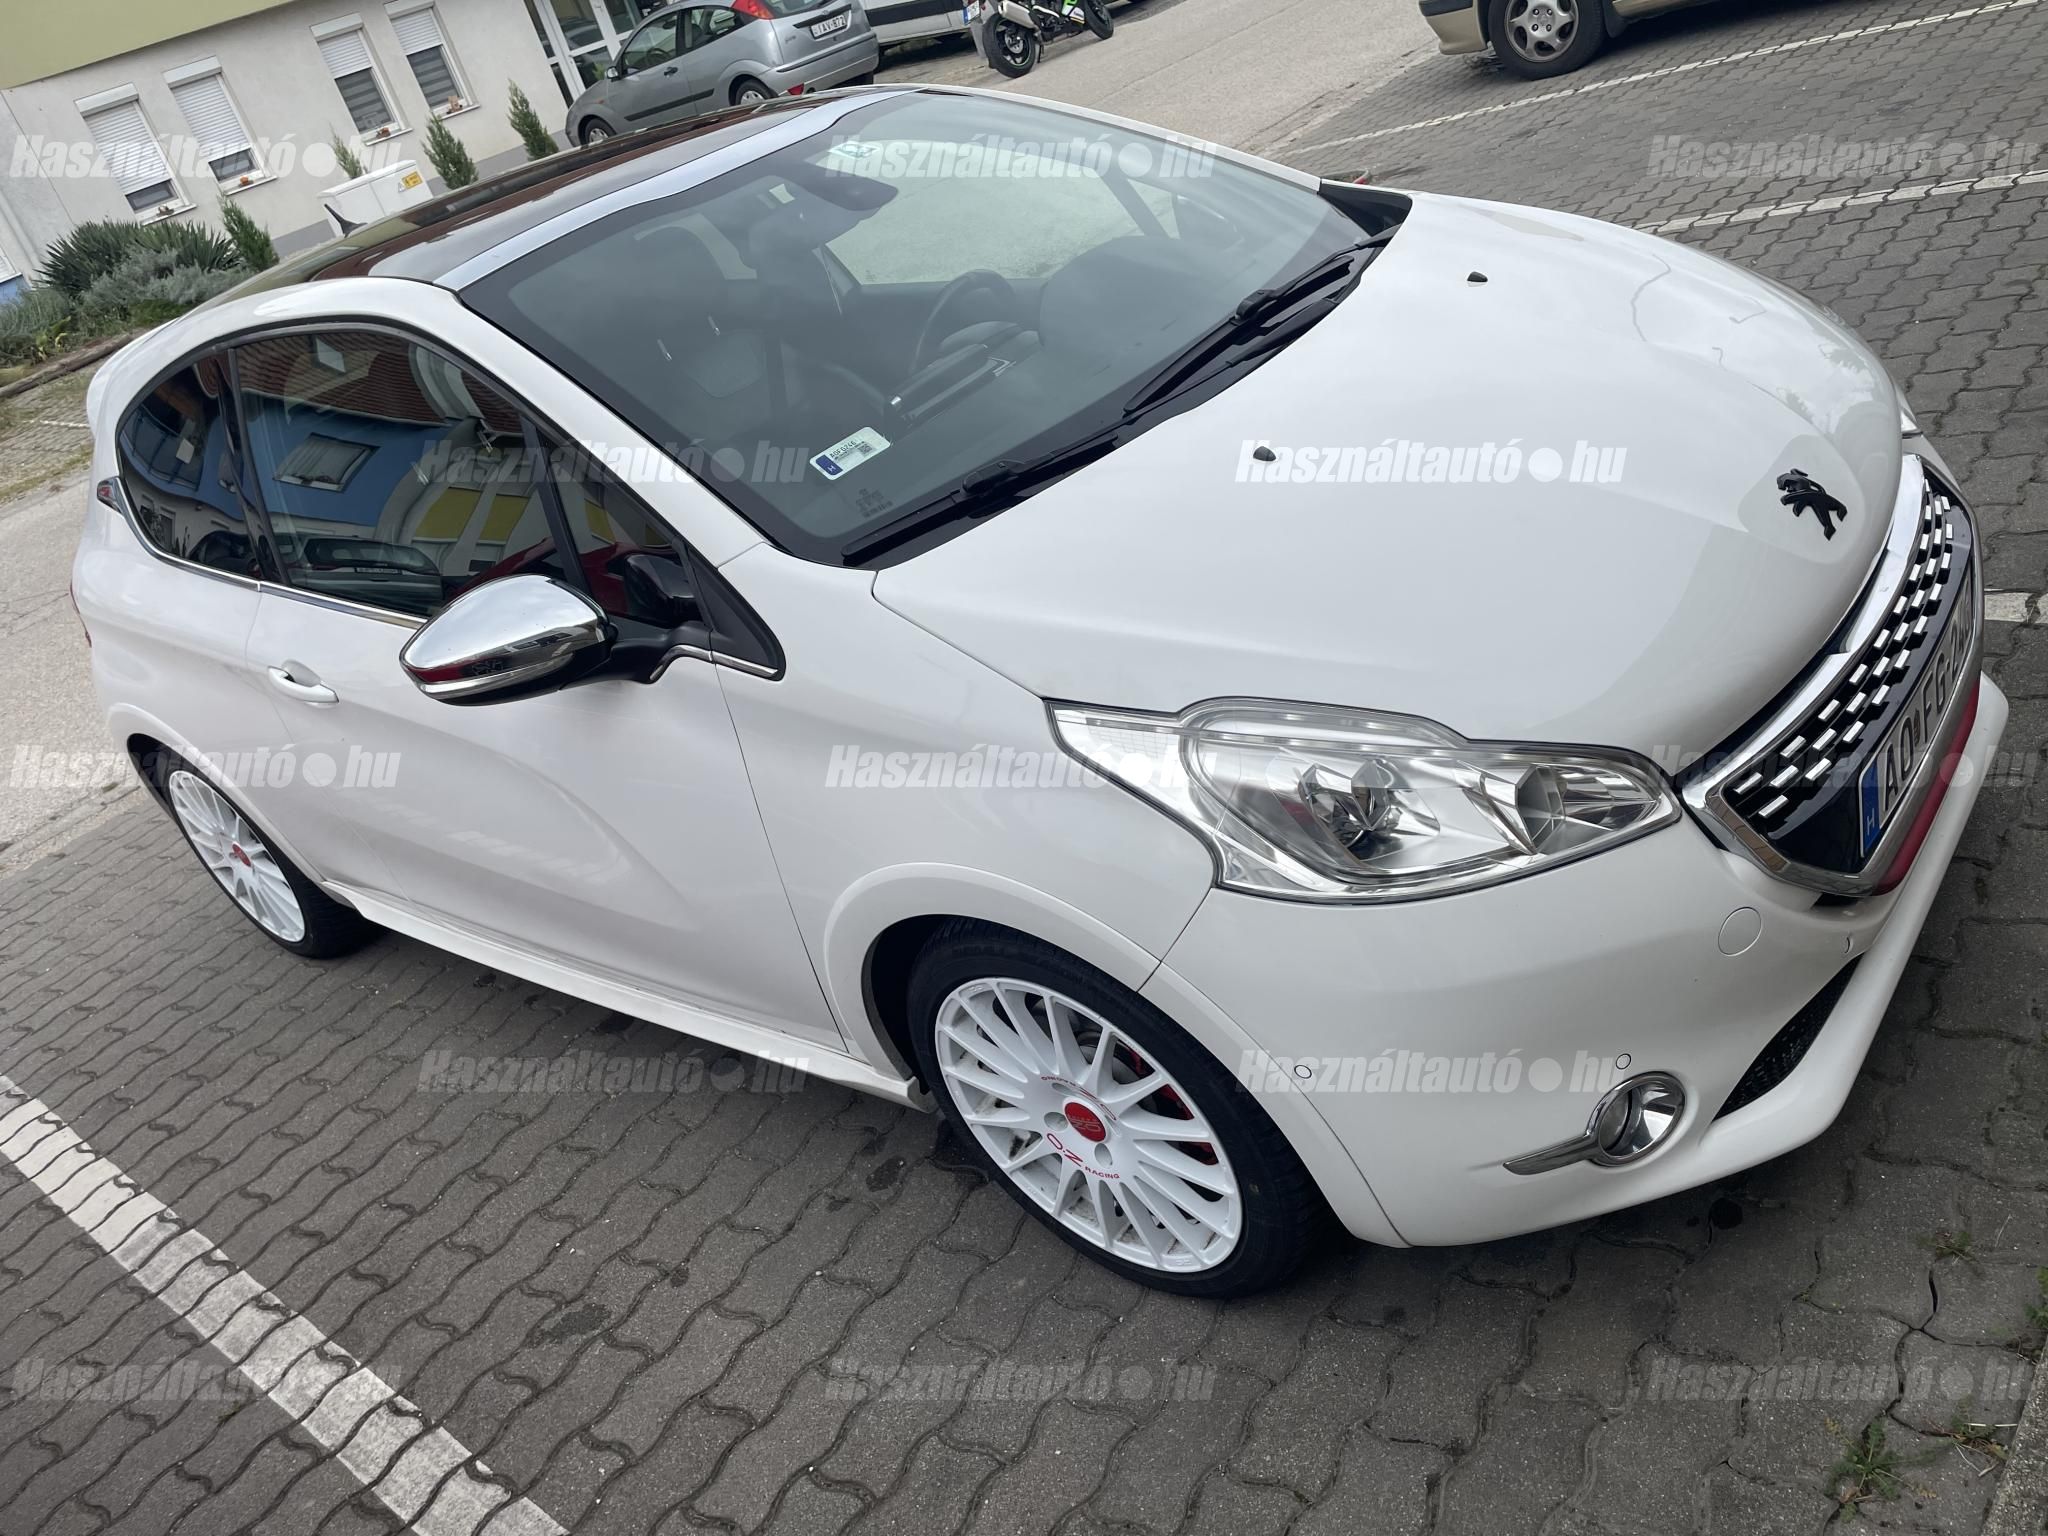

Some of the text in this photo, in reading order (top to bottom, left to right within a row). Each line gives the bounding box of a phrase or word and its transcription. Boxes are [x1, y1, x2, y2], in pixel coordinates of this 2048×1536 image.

[1866, 814, 1877, 838] H
[1883, 722, 1915, 812] AO
[1085, 1166, 1121, 1179] RACING
